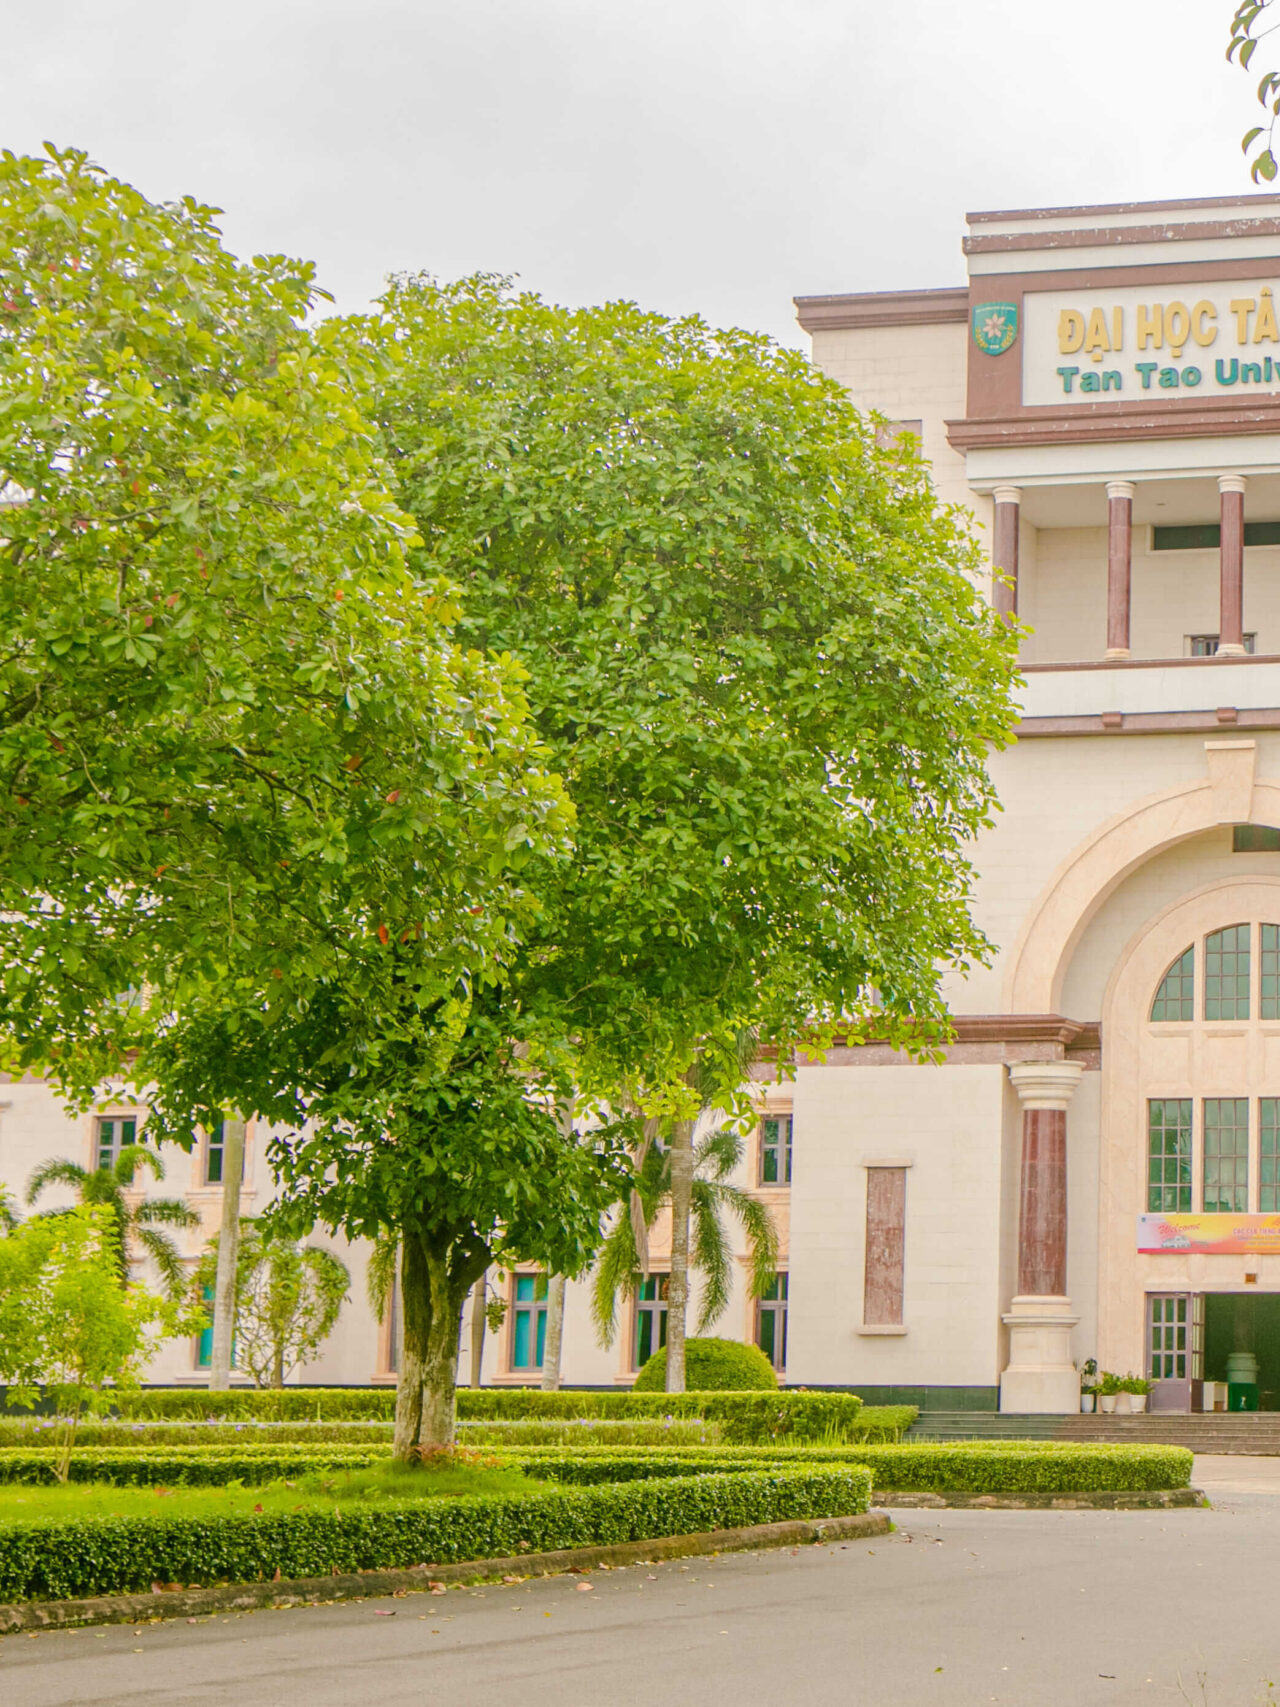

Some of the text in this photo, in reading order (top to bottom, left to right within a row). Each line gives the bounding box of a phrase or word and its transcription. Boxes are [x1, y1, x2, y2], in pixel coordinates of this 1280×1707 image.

[1058, 305, 1124, 361] ĐẠI
[1137, 297, 1218, 357] HỌC
[1057, 365, 1122, 393] Tan
[1135, 361, 1201, 390] Tao
